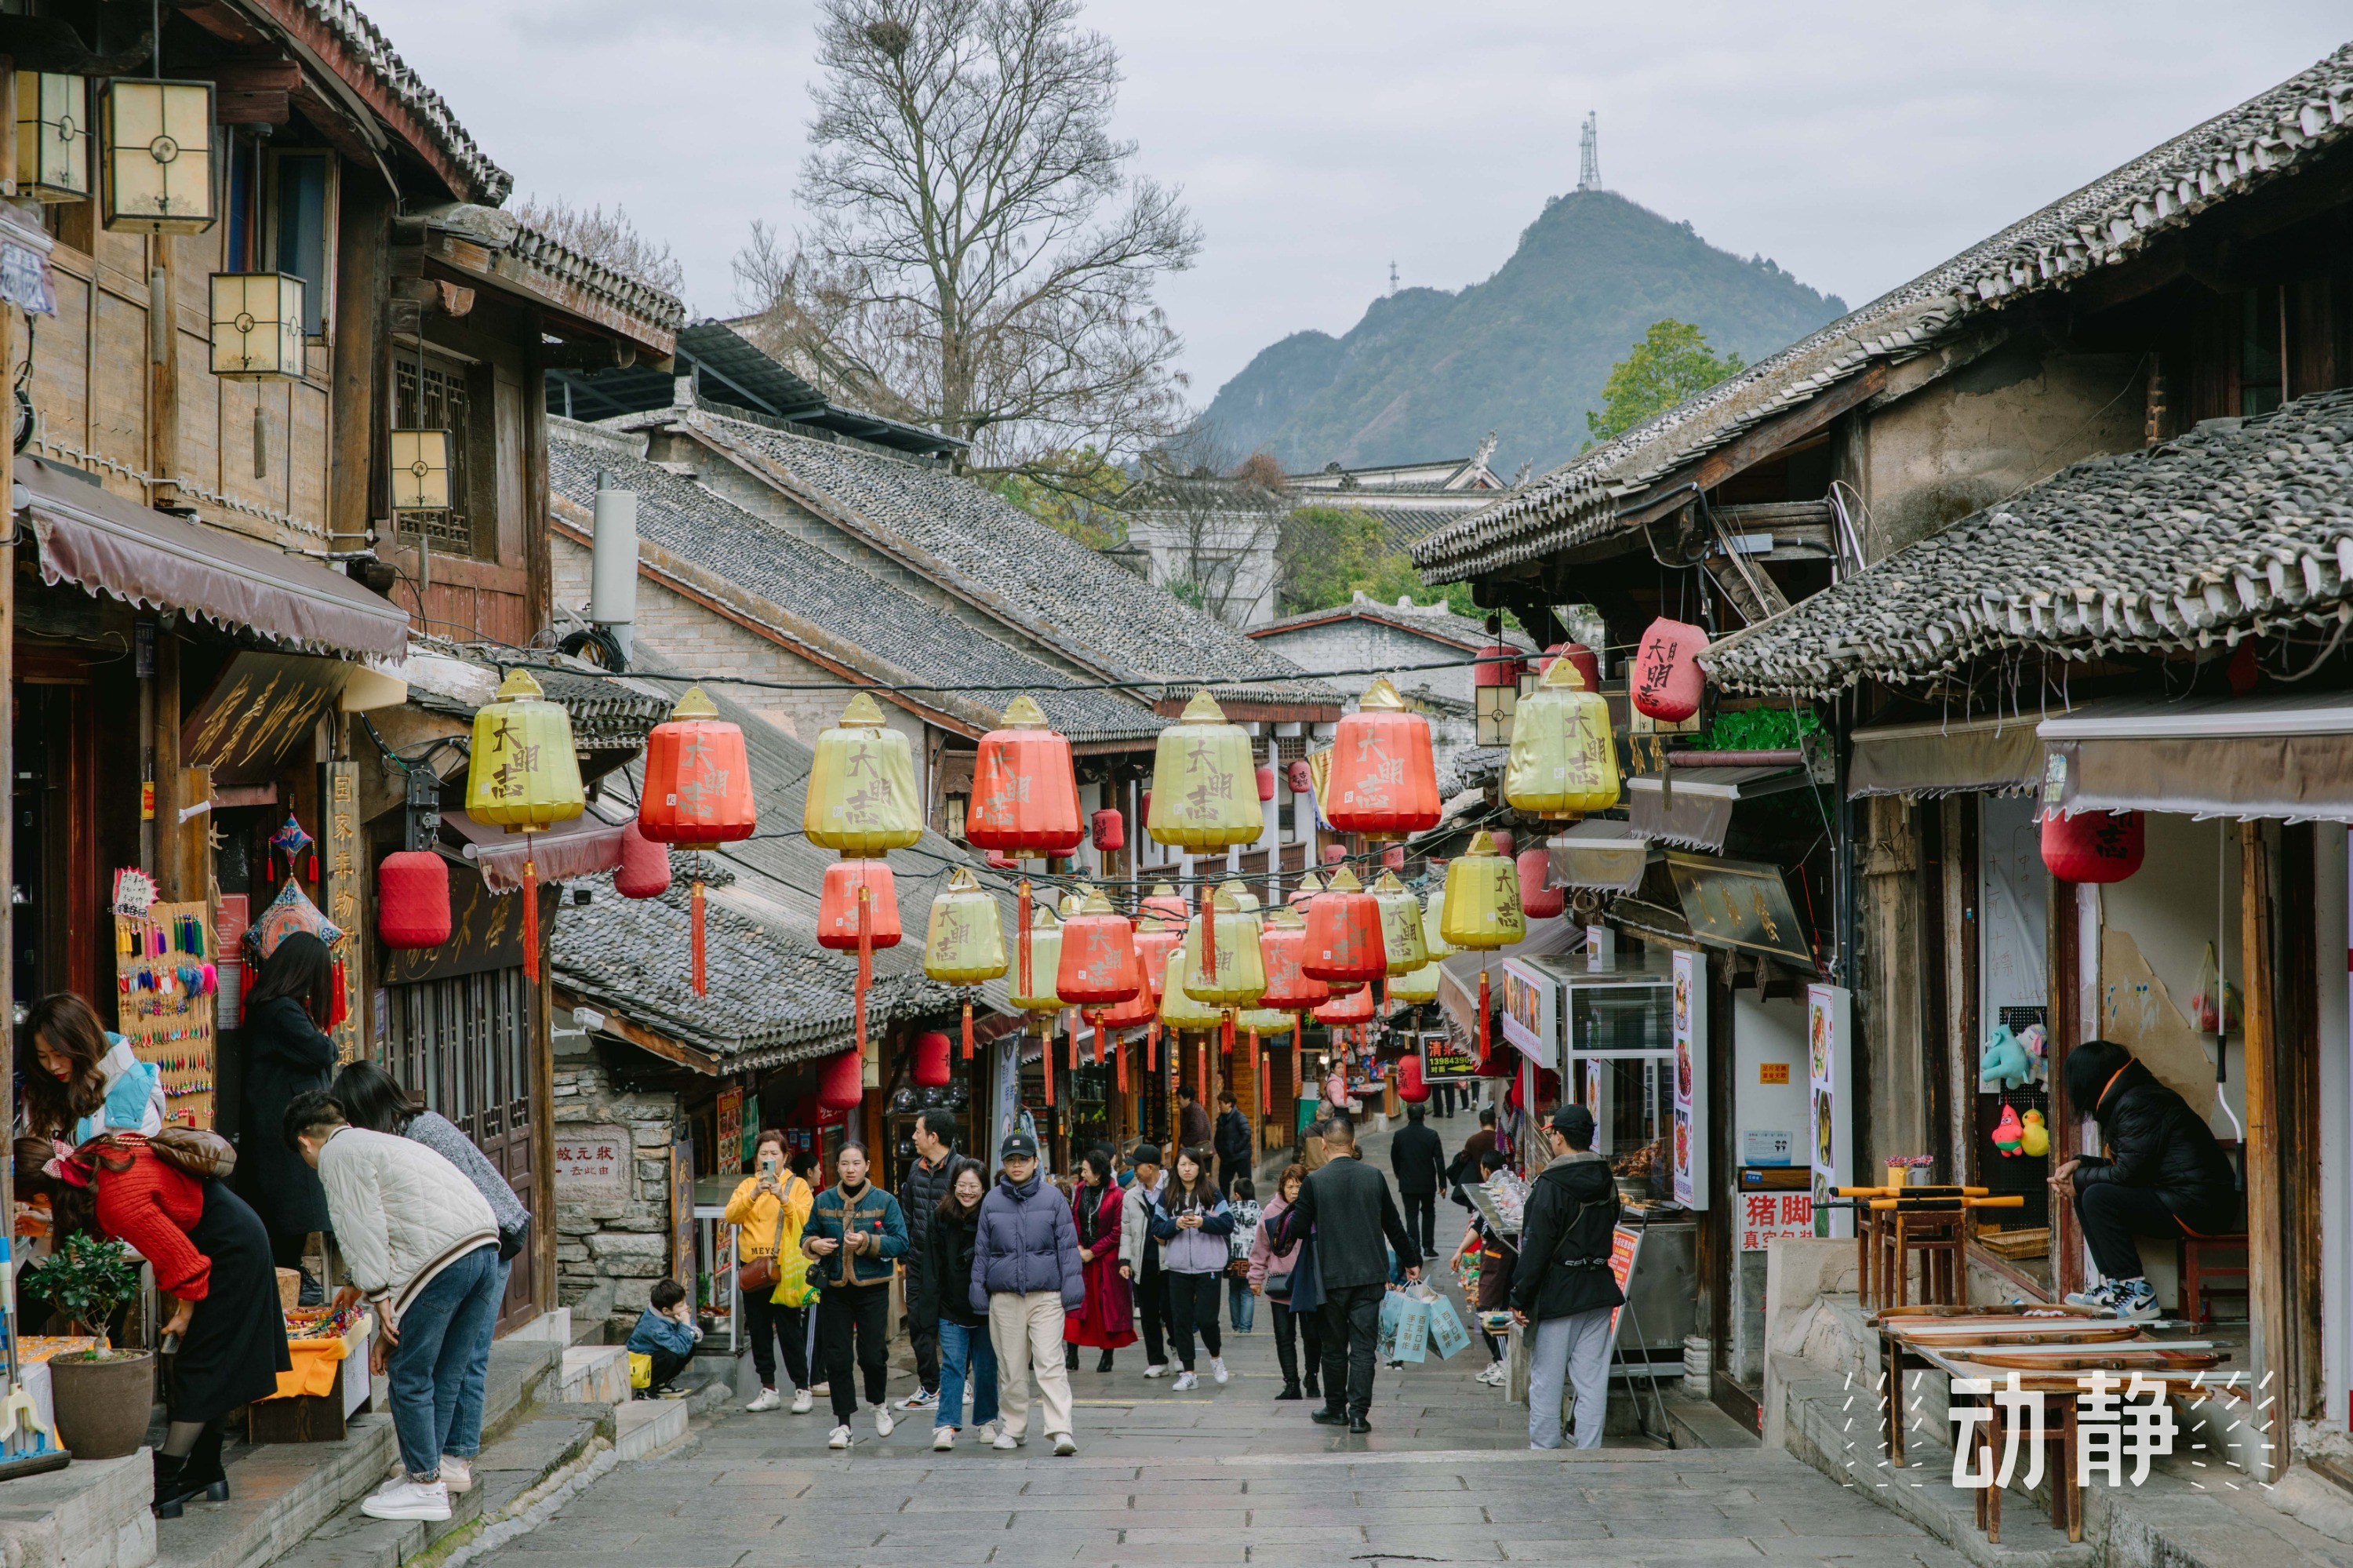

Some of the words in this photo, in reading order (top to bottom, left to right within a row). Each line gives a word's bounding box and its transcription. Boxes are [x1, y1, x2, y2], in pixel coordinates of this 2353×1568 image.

[1638, 638, 1674, 707] 大明志
[491, 717, 540, 800] 大明志
[1357, 729, 1406, 809] 大明志
[1564, 704, 1607, 787] 大明志
[679, 735, 729, 818] 大明志
[846, 744, 893, 825] 大明志
[985, 746, 1033, 826] 大明志
[1186, 740, 1233, 820] 大明志
[1496, 868, 1522, 928] 大明志
[936, 904, 969, 962] 大明志
[1087, 927, 1123, 986] 大明志
[1333, 904, 1367, 965] 大明志
[1387, 904, 1417, 957] 大明志
[1269, 942, 1300, 995] 大明志
[1746, 1195, 1812, 1228] 猪脚
[1402, 1314, 1416, 1350] 手工制作
[1413, 1315, 1426, 1352] 百年口味
